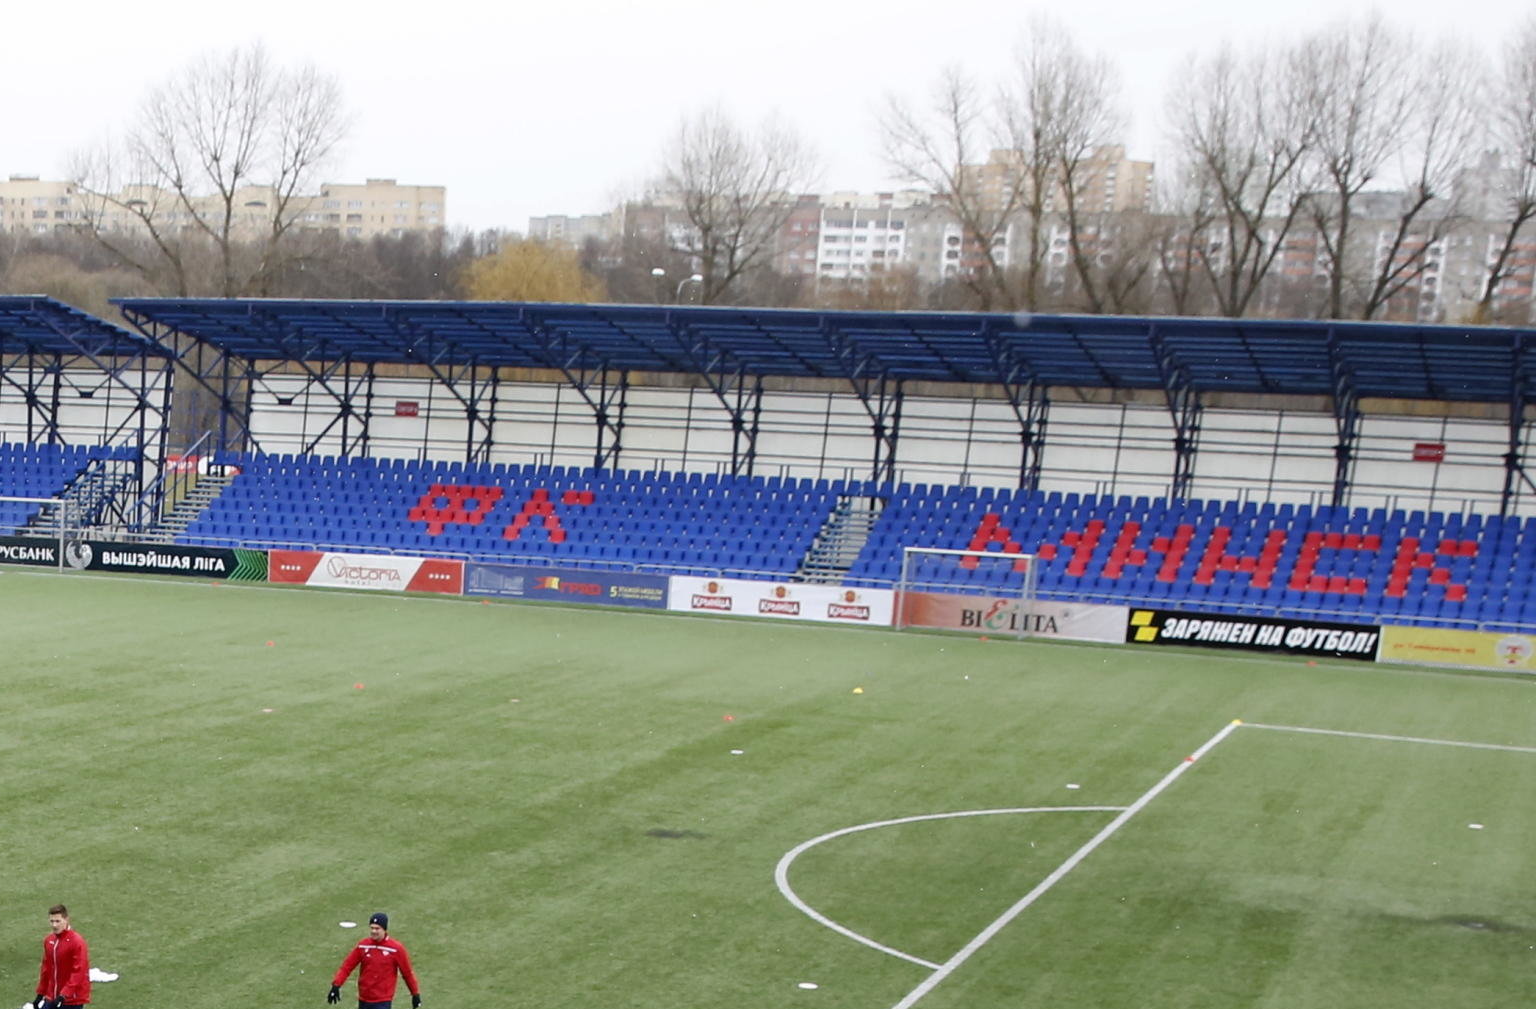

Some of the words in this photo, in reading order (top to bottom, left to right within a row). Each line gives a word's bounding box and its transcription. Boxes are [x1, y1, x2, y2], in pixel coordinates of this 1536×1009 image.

[102, 550, 190, 570] ВЫШЭЙШАЯ
[194, 555, 226, 572] ЛІГА
[1161, 618, 1252, 643] ЗАРЯЖЕН
[1255, 624, 1282, 646] НА
[1284, 626, 1377, 654] ФУТБОЛ!
